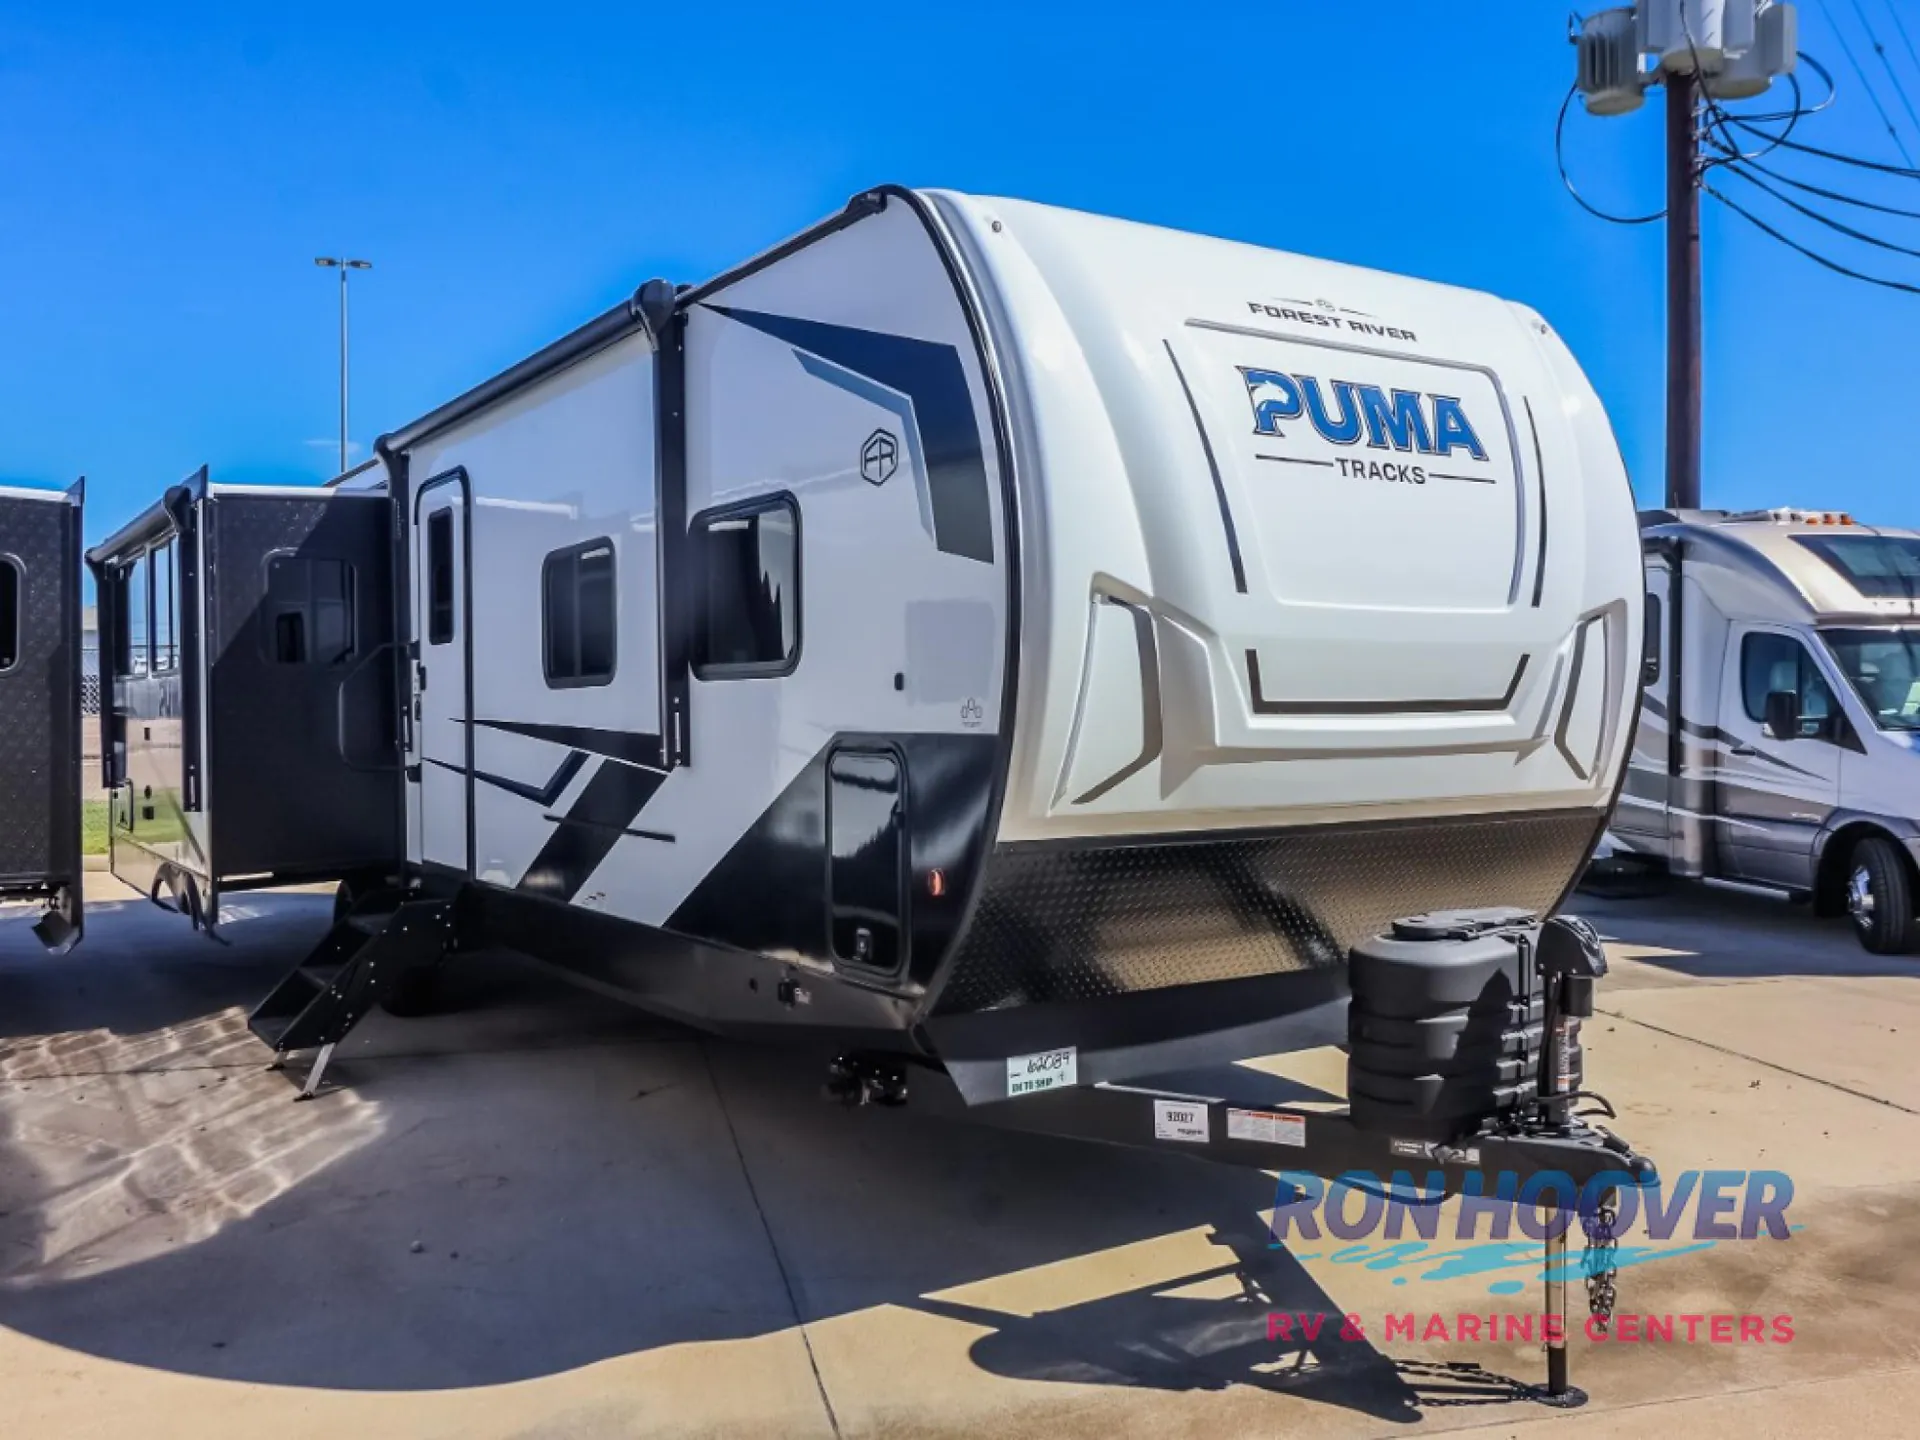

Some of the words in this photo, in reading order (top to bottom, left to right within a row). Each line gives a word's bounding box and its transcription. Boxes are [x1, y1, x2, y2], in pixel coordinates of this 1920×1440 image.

[1247, 301, 1342, 329] FOREST
[1347, 320, 1418, 342] RIVER
[1234, 365, 1490, 461] PUMA
[1335, 457, 1426, 484] TRACKS
